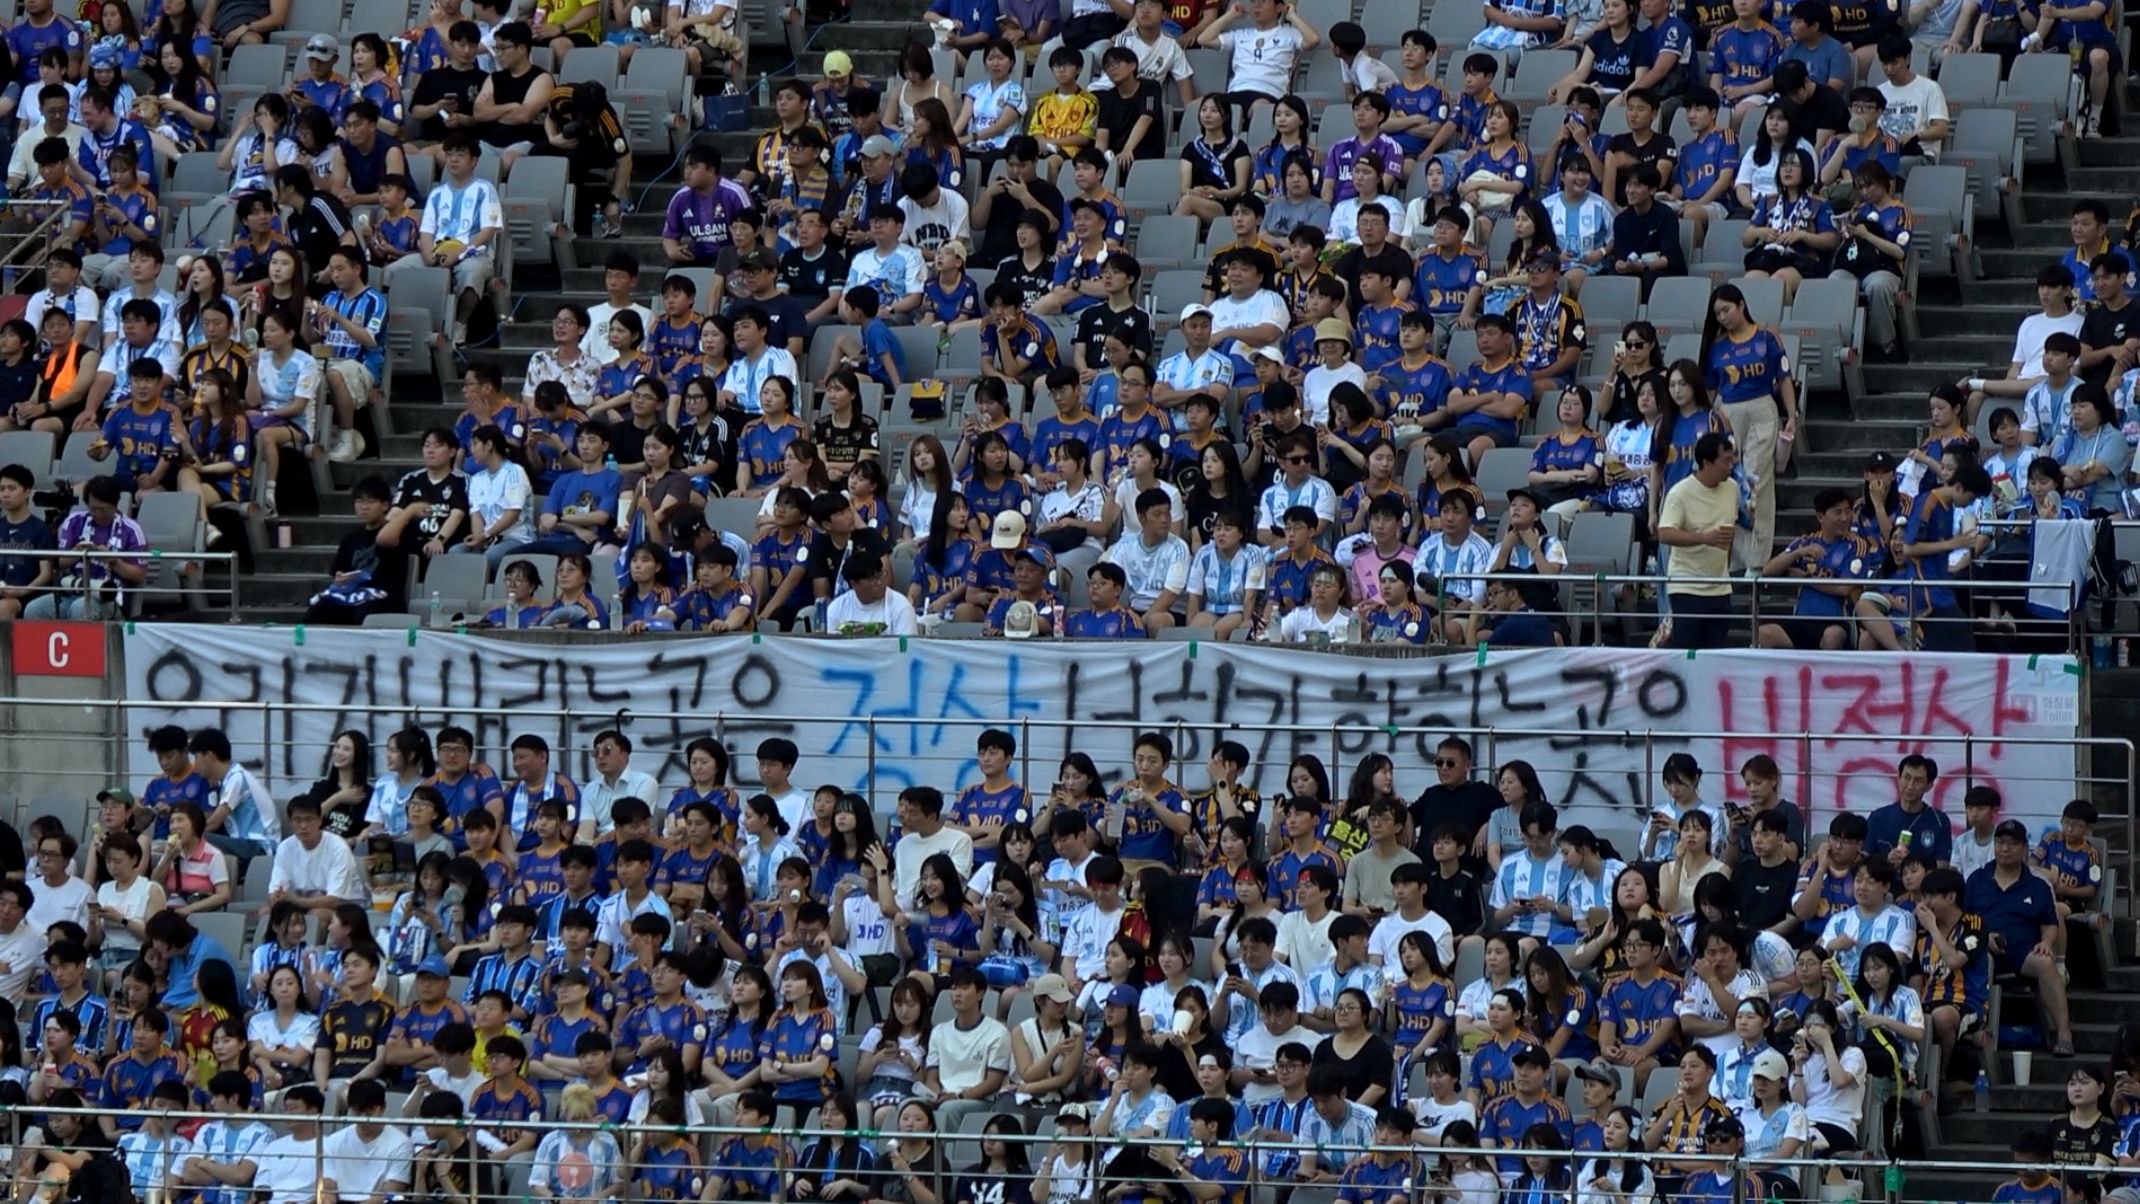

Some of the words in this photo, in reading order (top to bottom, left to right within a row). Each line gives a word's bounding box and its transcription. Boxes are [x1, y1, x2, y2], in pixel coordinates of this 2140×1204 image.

[1846, 8, 1867, 21] HD
[1591, 57, 1631, 76] adidas
[1741, 65, 1762, 79] HD
[1697, 164, 1715, 180] HD
[690, 223, 728, 237] ULSAN
[1446, 291, 1468, 305] HD
[1743, 363, 1765, 378] HD
[137, 442, 157, 456] HD
[419, 517, 440, 532] 66
[48, 631, 69, 668] C
[821, 654, 1041, 808] 정상
[1717, 656, 2029, 830] 비정상
[982, 814, 1004, 827] HD
[1141, 819, 1162, 833] HD
[2060, 872, 2078, 888] HD
[539, 881, 560, 895] HD
[867, 924, 885, 940] HD
[1407, 1015, 1430, 1029] HD
[350, 1036, 372, 1050] HD
[730, 1050, 753, 1063] HD
